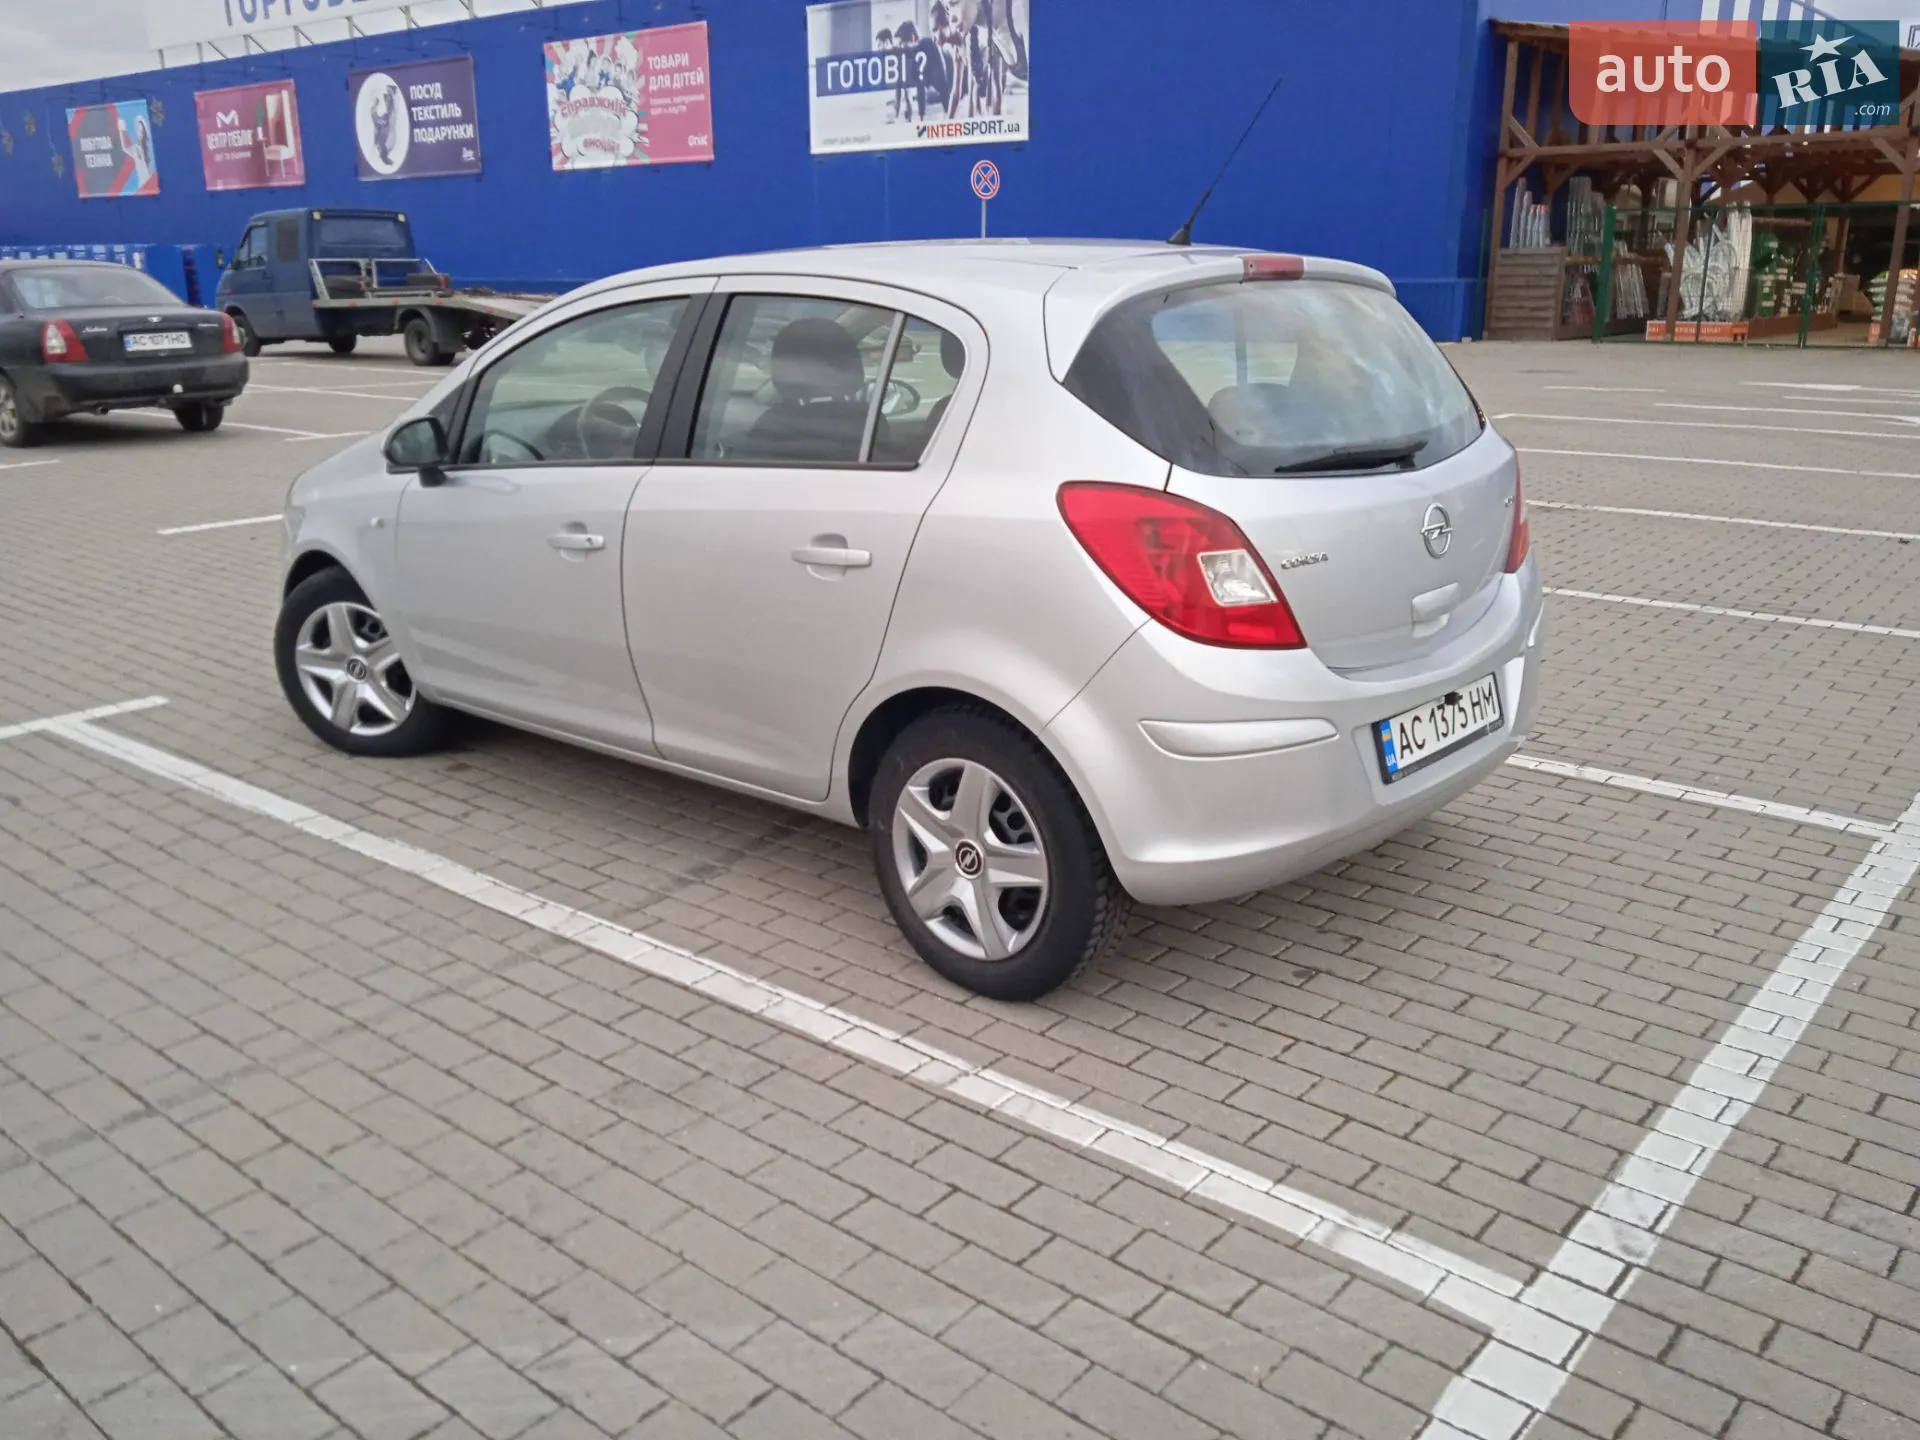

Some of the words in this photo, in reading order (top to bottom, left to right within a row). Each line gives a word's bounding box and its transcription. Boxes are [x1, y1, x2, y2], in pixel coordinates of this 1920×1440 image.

[647, 52, 689, 70] ТОВАРИ
[649, 75, 671, 92] ДЛЯ
[672, 66, 705, 90] ДІТЕЙ
[826, 53, 907, 90] ГОТОВІ
[410, 82, 443, 100] ПОСУД
[411, 102, 462, 121] ТЕКСТИЛЬ
[413, 123, 474, 143] ПОДАРУНКИ
[927, 120, 1020, 139] INTERSPORT.ua
[1400, 714, 1426, 759] AC
[1468, 681, 1496, 725] HM
